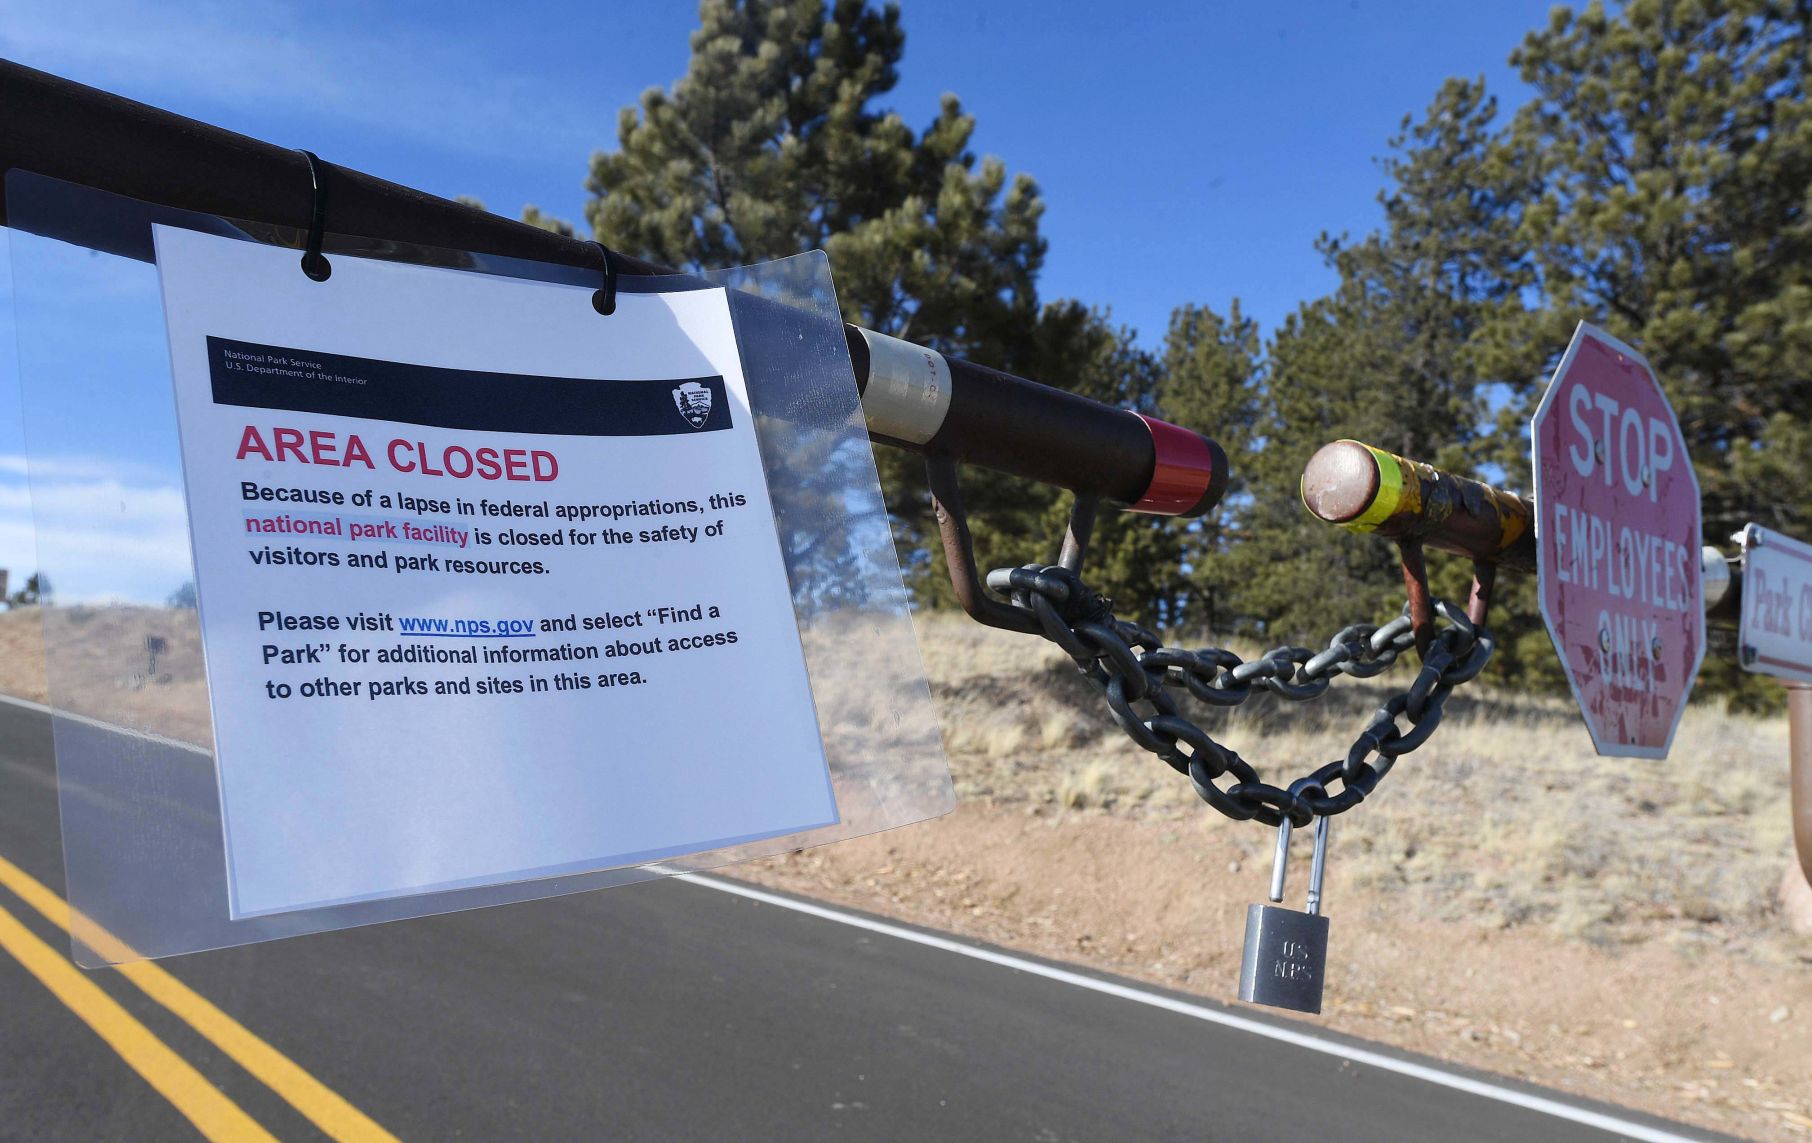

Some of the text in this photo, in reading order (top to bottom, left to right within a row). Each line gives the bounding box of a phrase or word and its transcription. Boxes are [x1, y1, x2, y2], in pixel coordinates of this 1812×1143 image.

[223, 349, 323, 370] National Park Service
[225, 361, 368, 386] U.S. Department of the Interior
[236, 425, 559, 482] AREA CLOSED
[1569, 382, 1674, 503] STOP
[241, 481, 747, 521] Because of a lapse in federal appropriations, this
[245, 514, 724, 548] national park facility is closed for the safety of
[249, 546, 550, 575] visitors and park resources.
[1554, 503, 1690, 613] EMPLOYEES
[1752, 567, 1793, 638] Park
[258, 604, 720, 637] Please visit www.nps.gov and select “Find a
[262, 630, 738, 665] Park” for additional information about access
[1598, 609, 1658, 694] ONLY
[265, 670, 647, 700] to other parks and sites in this area.
